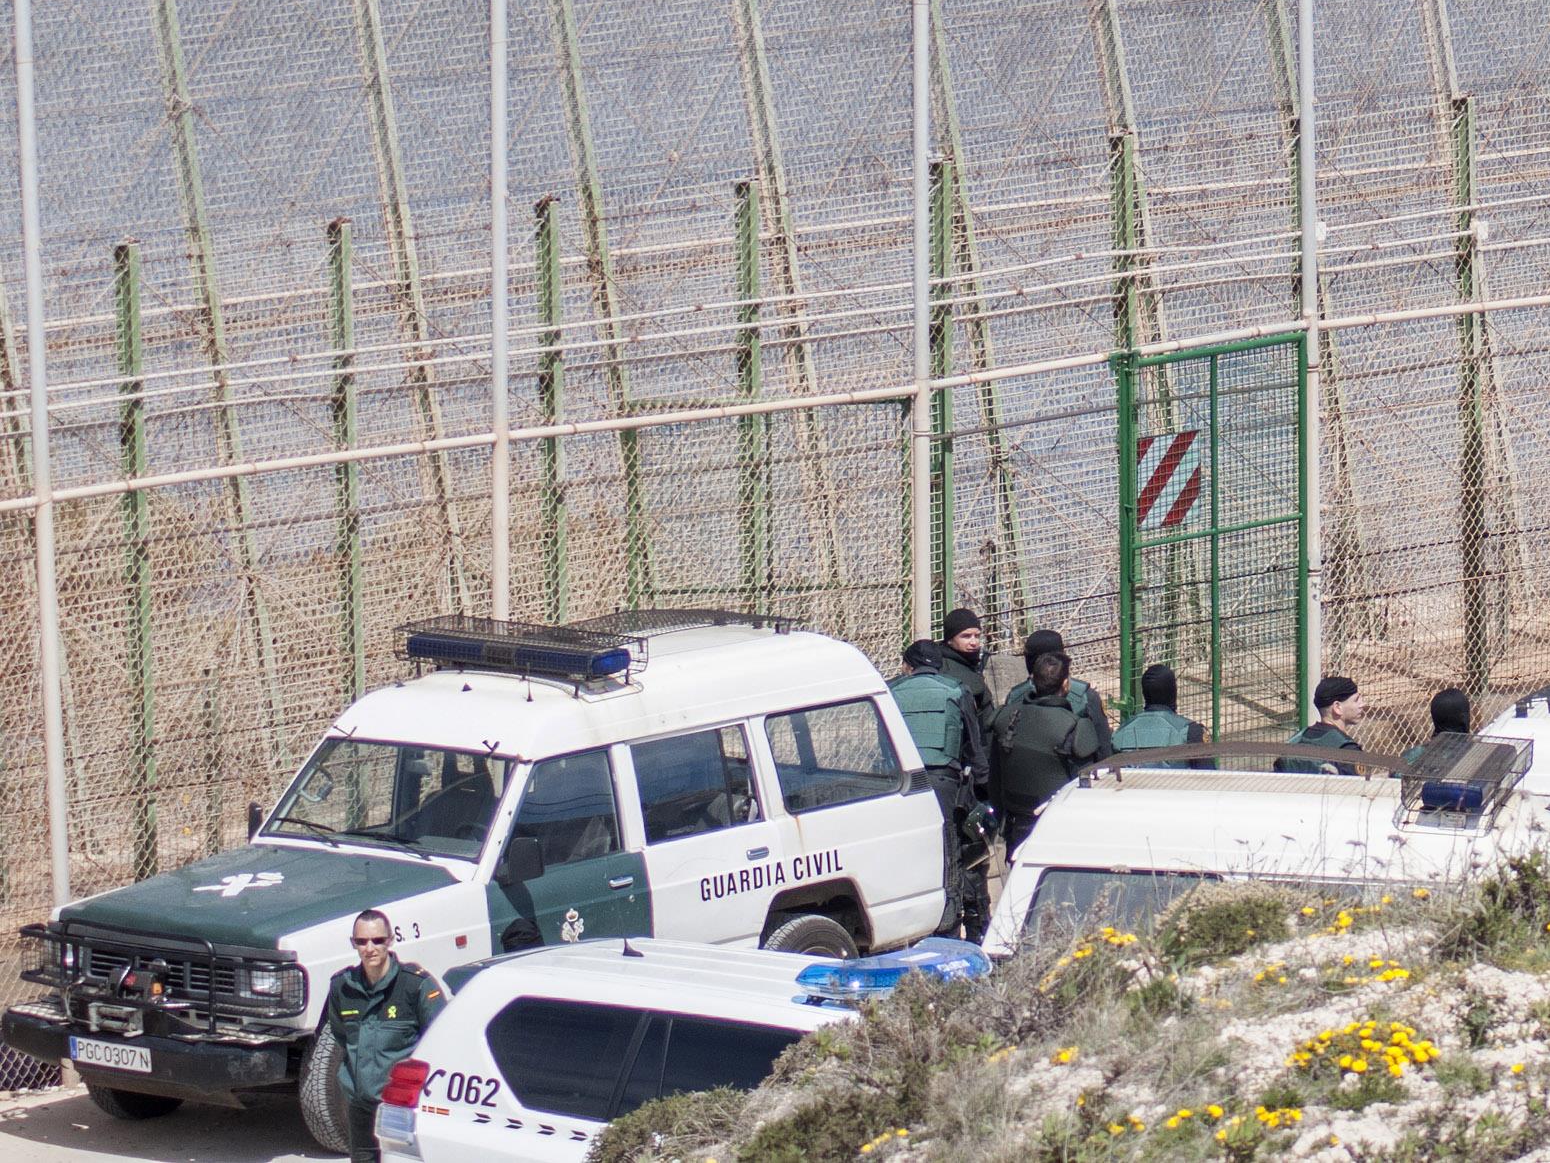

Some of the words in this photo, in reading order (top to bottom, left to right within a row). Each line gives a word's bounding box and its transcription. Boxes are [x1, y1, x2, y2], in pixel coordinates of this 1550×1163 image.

[700, 861, 786, 902] GUARDIA
[793, 849, 844, 881] CIVIL
[412, 922, 420, 939] 3
[446, 1071, 501, 1108] 062
